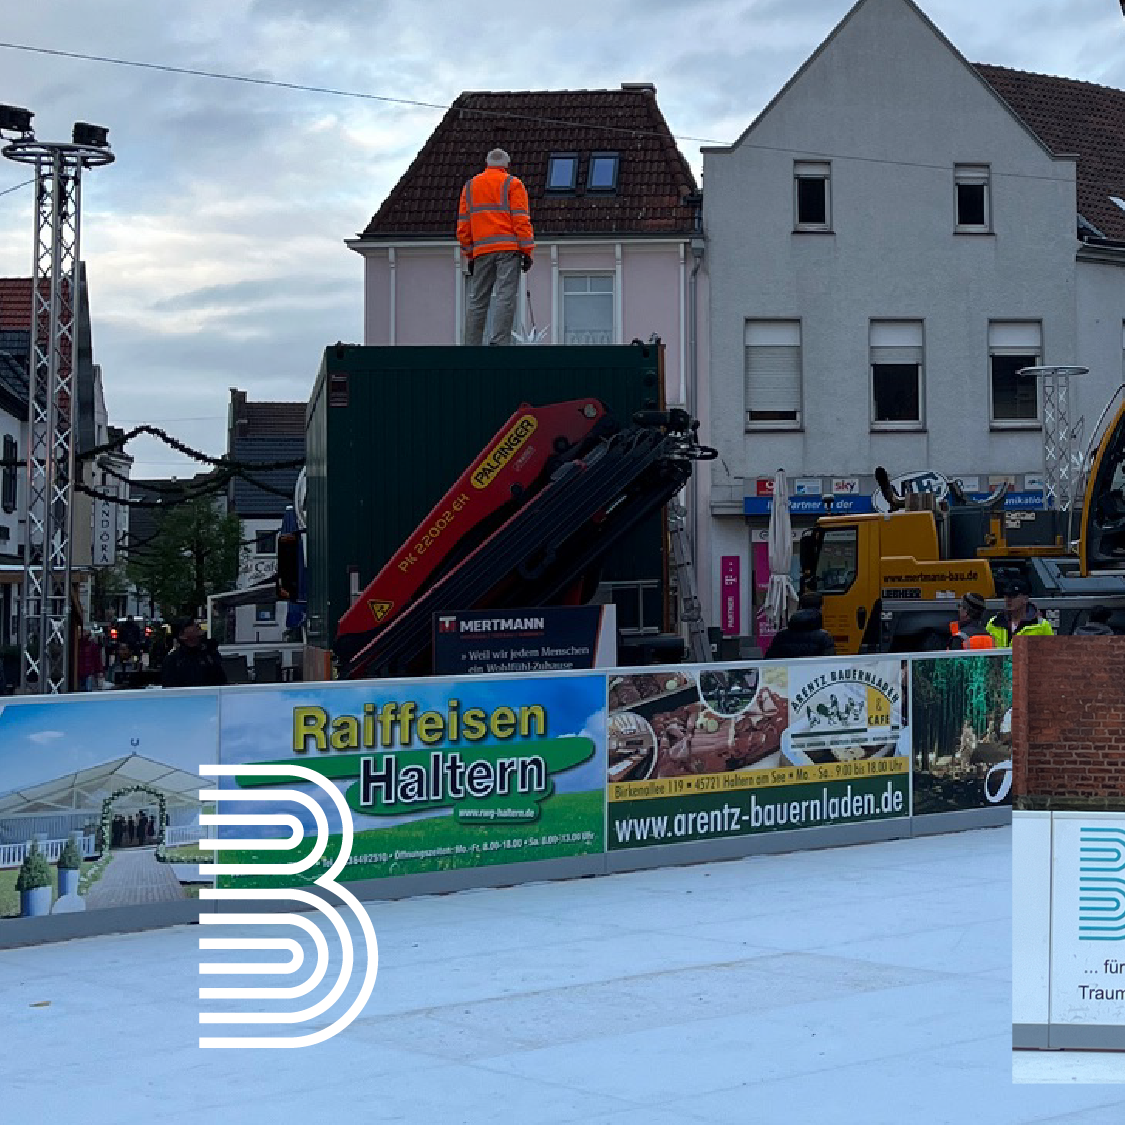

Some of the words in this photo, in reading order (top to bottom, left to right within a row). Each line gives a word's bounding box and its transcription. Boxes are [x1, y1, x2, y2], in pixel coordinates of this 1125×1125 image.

[474, 419, 536, 486] PALFINGER
[834, 480, 858, 493] sky
[460, 618, 545, 633] MERTMANN
[468, 649, 491, 661] Weil
[492, 649, 509, 659] wir
[510, 648, 540, 661] jedem
[541, 646, 590, 657] Menschen
[791, 674, 827, 714] ARENTZ
[293, 699, 545, 753] Raiffeisen
[360, 751, 547, 806] Haltern
[615, 782, 665, 800] Birkenallee
[669, 780, 684, 793] 119
[695, 776, 721, 790] 45721
[723, 774, 754, 787] Haltern
[756, 775, 769, 785] am
[771, 771, 786, 783] See
[854, 762, 865, 775] bis
[890, 759, 903, 772] Uhr
[615, 781, 903, 843] www.arentz-bauernladen.de
[1104, 959, 1125, 974] für
